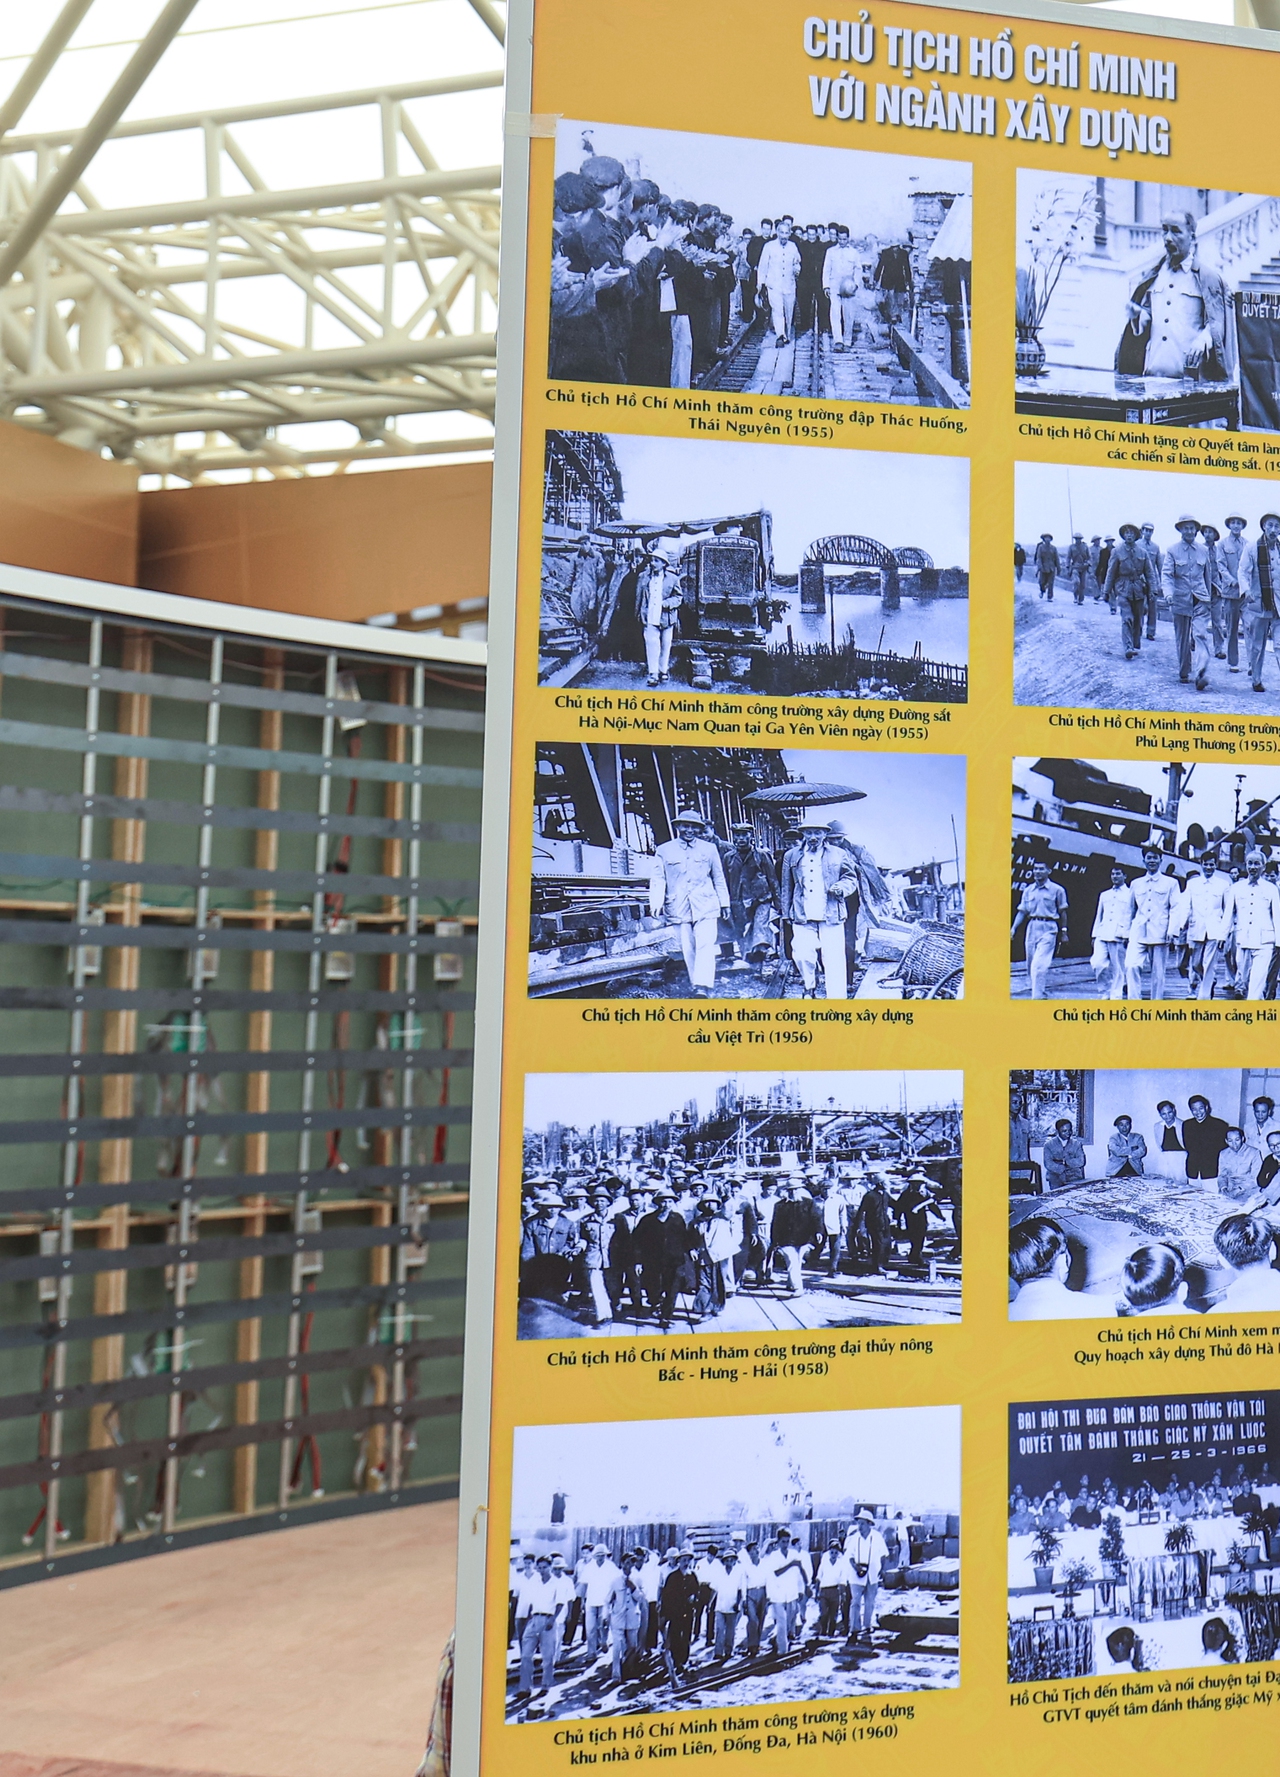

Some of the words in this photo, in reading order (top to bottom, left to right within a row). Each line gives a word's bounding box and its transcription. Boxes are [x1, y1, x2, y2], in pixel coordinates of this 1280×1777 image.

[803, 9, 874, 63] CHỦ
[883, 25, 960, 78] TỊCH
[969, 28, 1014, 80] HỒ
[1024, 41, 1079, 88] CHÍ
[1088, 51, 1176, 100] MINH
[808, 70, 865, 120] VỚI
[875, 81, 996, 136] NGÀNH
[1004, 93, 1071, 144] XÂY
[1079, 107, 1170, 158] DỰNG
[1242, 302, 1270, 318] QUYẾT
[545, 388, 575, 403] Chủ
[580, 391, 610, 407] tịch
[616, 392, 637, 407] Hồ
[641, 395, 668, 409] Chí
[673, 398, 711, 412] Minh
[716, 400, 754, 415] thăm
[759, 404, 793, 422] công
[798, 407, 844, 426] trường
[848, 409, 875, 427] đập
[880, 412, 914, 427] Thác
[919, 415, 968, 434] Huống,
[688, 416, 720, 431] Thái
[726, 420, 781, 438] Nguyên
[786, 424, 834, 440] (1955)
[1018, 423, 1044, 437] Chủ
[1046, 425, 1070, 440] tịch
[1073, 425, 1092, 440] Hồ
[1094, 429, 1116, 442] Chí
[1118, 431, 1150, 445] Minh
[1153, 434, 1179, 451] tặng
[1181, 436, 1197, 448] cờ
[1198, 437, 1234, 454] Quyết
[1237, 441, 1260, 454] tâm
[1107, 447, 1128, 460] các
[1130, 449, 1164, 463] chiến
[1166, 452, 1176, 464] sĩ
[1179, 452, 1201, 466] làm
[1204, 457, 1239, 472] đường
[1241, 459, 1262, 471] sắt.
[1053, 1008, 1079, 1022] Chủ
[1081, 1008, 1105, 1025] tịch
[1109, 1006, 1128, 1022] Hồ
[1130, 1008, 1152, 1022] Chí
[1155, 1008, 1187, 1022] Minh
[1190, 1008, 1222, 1022] thăm
[1224, 1008, 1254, 1025] cảng
[1256, 1008, 1277, 1022] Hải
[1017, 1411, 1036, 1432] ĐẠI
[1040, 1408, 1059, 1431] HỘI
[1062, 1409, 1080, 1427] THI
[1164, 1404, 1188, 1422] GIAO
[1191, 1400, 1222, 1420] THÔNG
[1226, 1398, 1246, 1419] VẬN
[1019, 1431, 1053, 1456] QUYẾT
[1060, 1431, 1082, 1452] TÂM
[1088, 1429, 1118, 1450] ĐÁNH
[1165, 1425, 1189, 1446] GIẶC
[1212, 1422, 1234, 1442] XÂM
[1132, 1453, 1146, 1463] 21
[1171, 1449, 1191, 1460] 25
[1206, 1448, 1217, 1457] 3
[1232, 1444, 1267, 1456] 1966
[553, 1728, 584, 1746] Chủ
[588, 1726, 617, 1746] tịch
[622, 1721, 645, 1740] Hồ
[648, 1722, 675, 1738] Chí
[678, 1718, 718, 1735] Minh
[722, 1716, 760, 1732] thăm
[764, 1713, 798, 1730] công
[802, 1709, 849, 1726] trường
[852, 1706, 876, 1723] xây
[880, 1703, 915, 1721] dựng
[570, 1749, 598, 1766] khu
[602, 1747, 630, 1763] nhà
[634, 1744, 645, 1760] ở
[648, 1743, 677, 1759] Kim
[682, 1740, 717, 1756] Liên,
[723, 1734, 762, 1754] Đống
[766, 1734, 791, 1749] Đa,
[796, 1731, 817, 1746] Hà
[822, 1727, 847, 1746] Nội
[851, 1724, 898, 1742] (1960)
